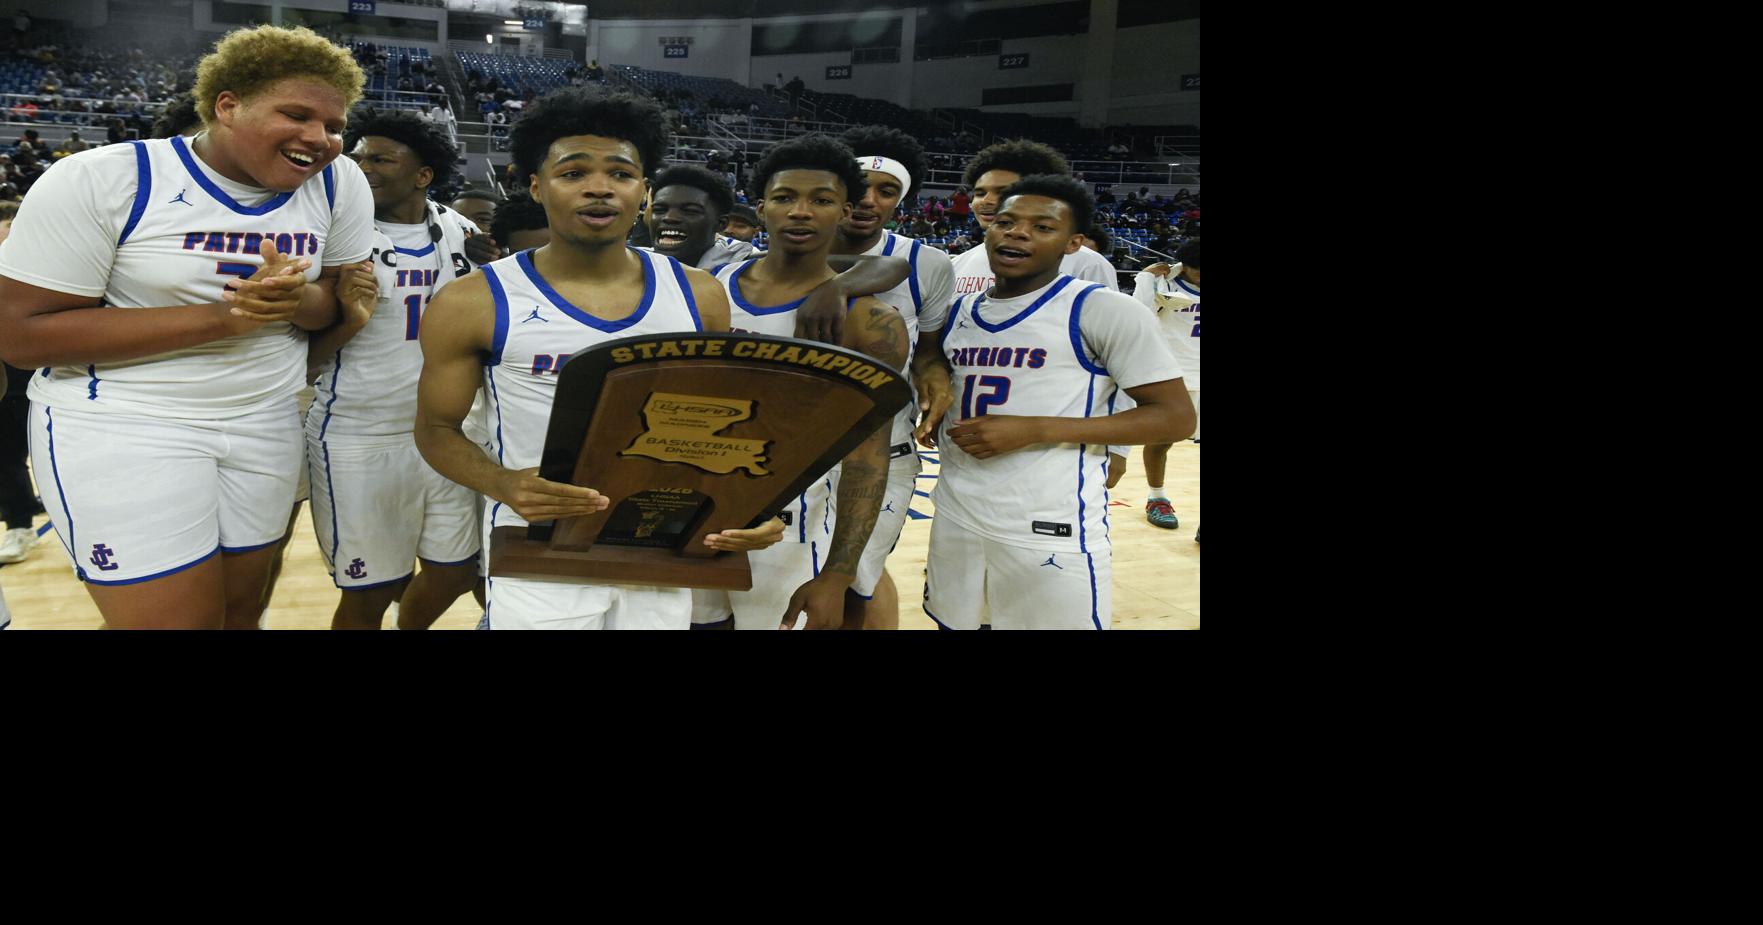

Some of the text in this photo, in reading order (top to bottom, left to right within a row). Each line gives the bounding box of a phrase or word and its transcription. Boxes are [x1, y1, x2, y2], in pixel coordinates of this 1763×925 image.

[352, 3, 372, 11] 223
[526, 20, 543, 28] 224
[1003, 56, 1025, 66] 227
[829, 69, 848, 77] 226
[610, 340, 894, 389] STATE CHAMPION
[645, 437, 753, 452] BASKETBALL
[664, 446, 718, 457] Division
